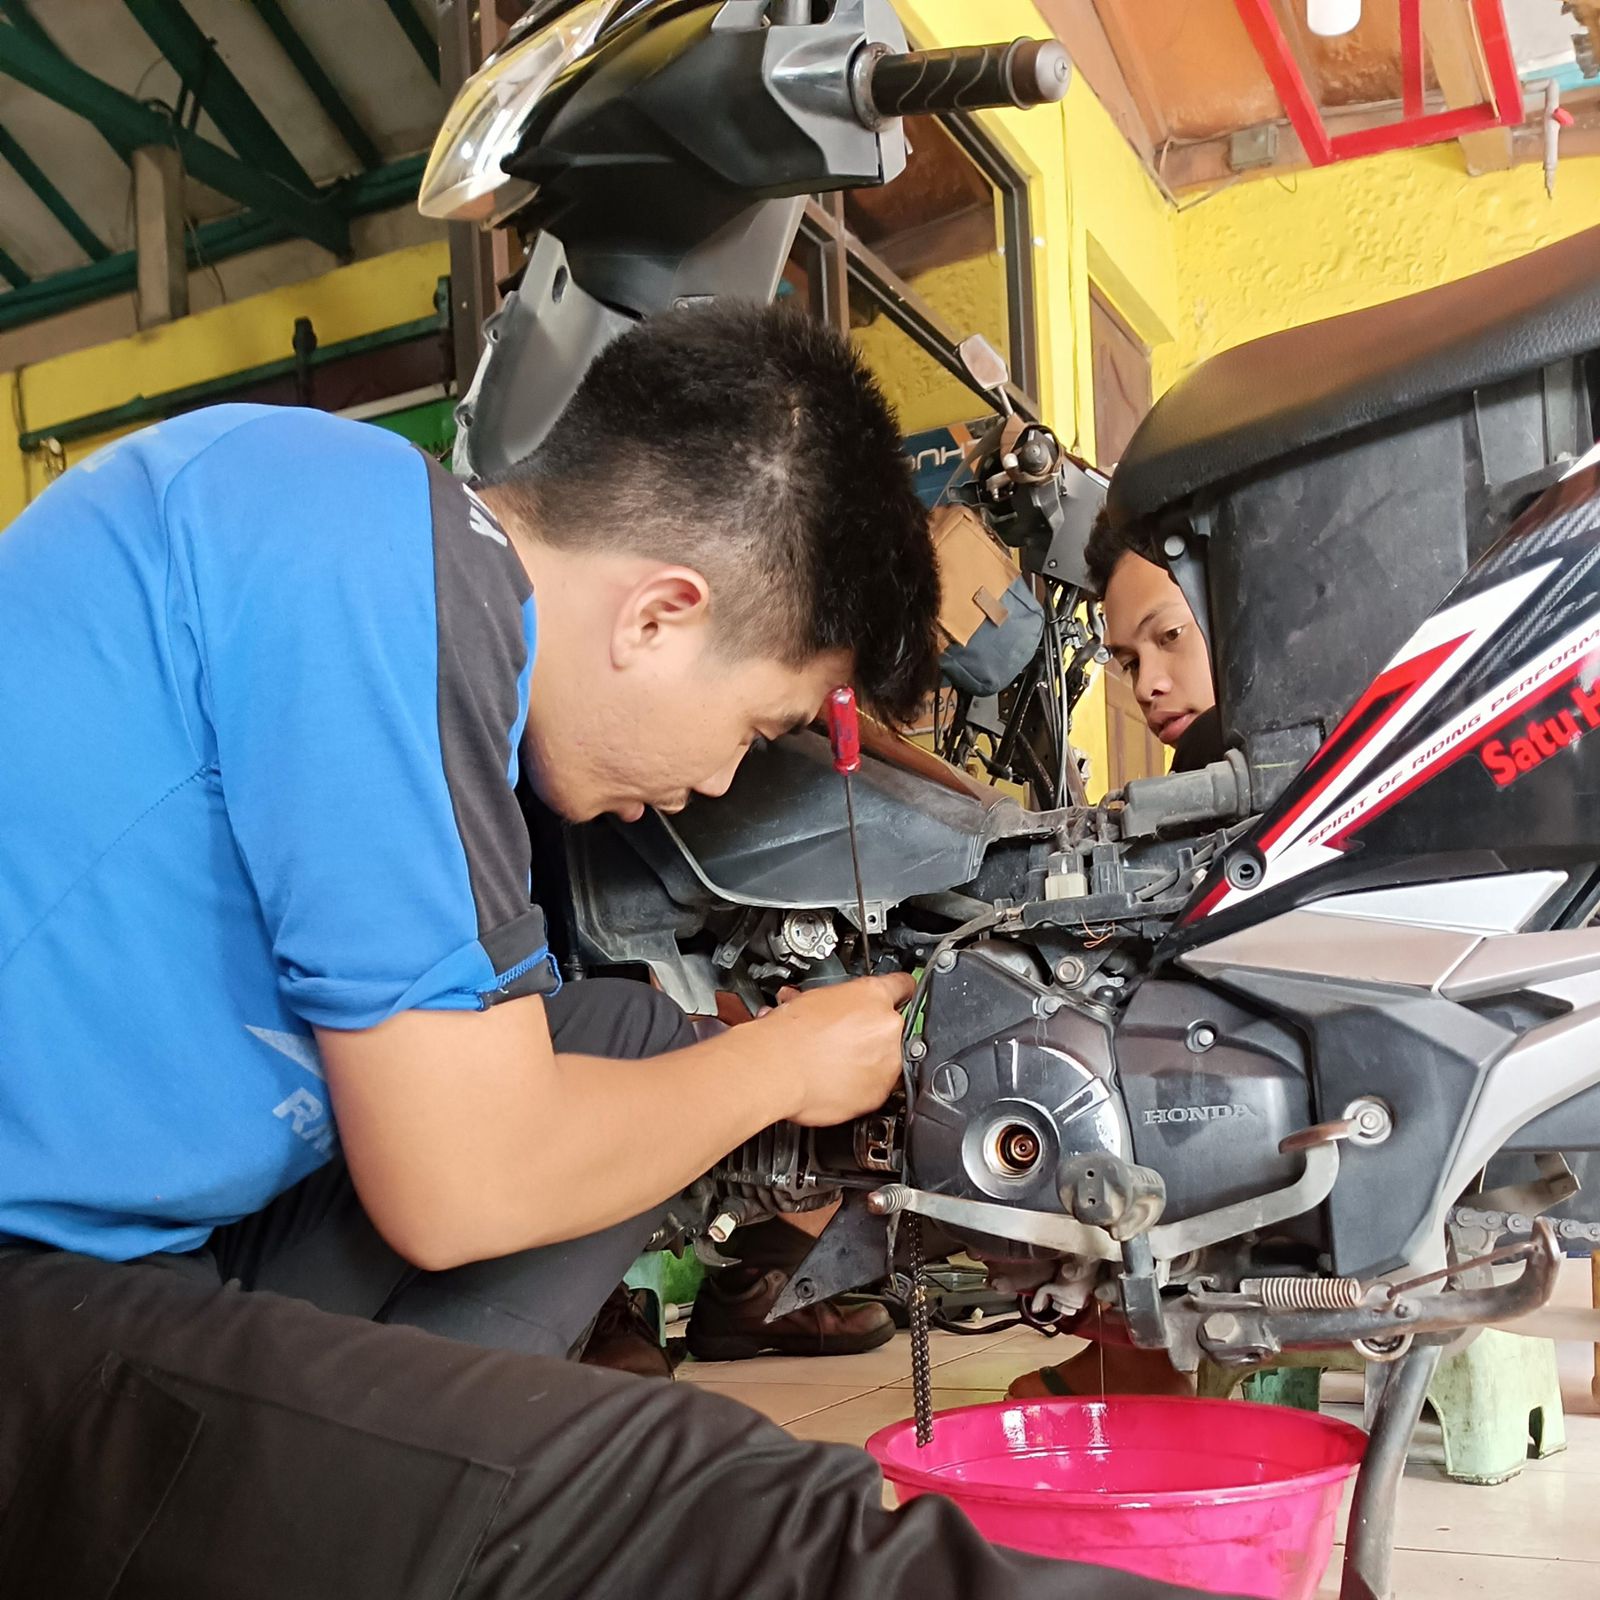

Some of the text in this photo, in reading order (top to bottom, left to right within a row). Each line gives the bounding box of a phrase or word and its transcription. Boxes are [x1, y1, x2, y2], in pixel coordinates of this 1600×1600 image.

[1308, 796, 1368, 846] SPIRIT
[1377, 770, 1404, 795] OF
[1411, 713, 1482, 770] RIDING
[1482, 709, 1580, 786] Satu
[1144, 1104, 1258, 1125] HONDA
